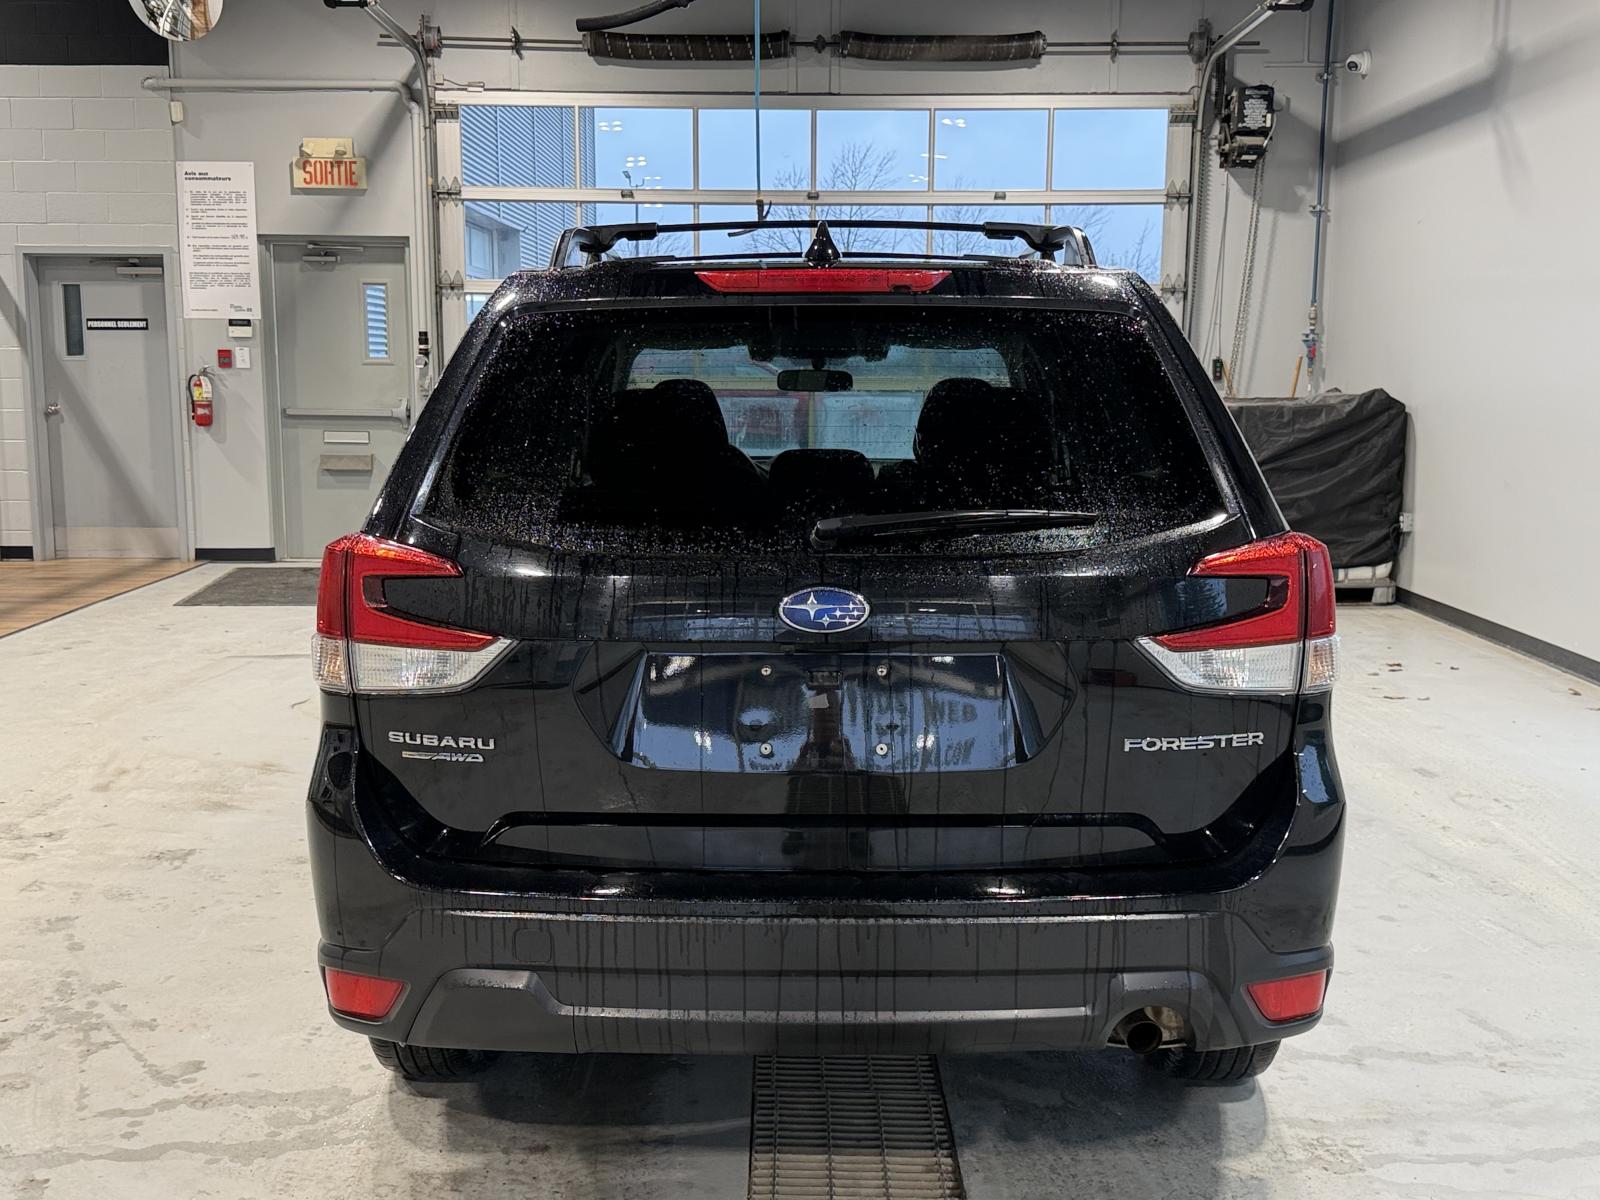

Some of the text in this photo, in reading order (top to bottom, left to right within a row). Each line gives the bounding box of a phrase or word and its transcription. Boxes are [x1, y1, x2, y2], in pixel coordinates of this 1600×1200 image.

[303, 160, 358, 186] SORTIE
[87, 320, 147, 328] PERSONNEL SEULEMENT
[388, 731, 495, 750] SUBARU
[1124, 732, 1265, 752] FORESTER
[432, 752, 485, 762] AWD
